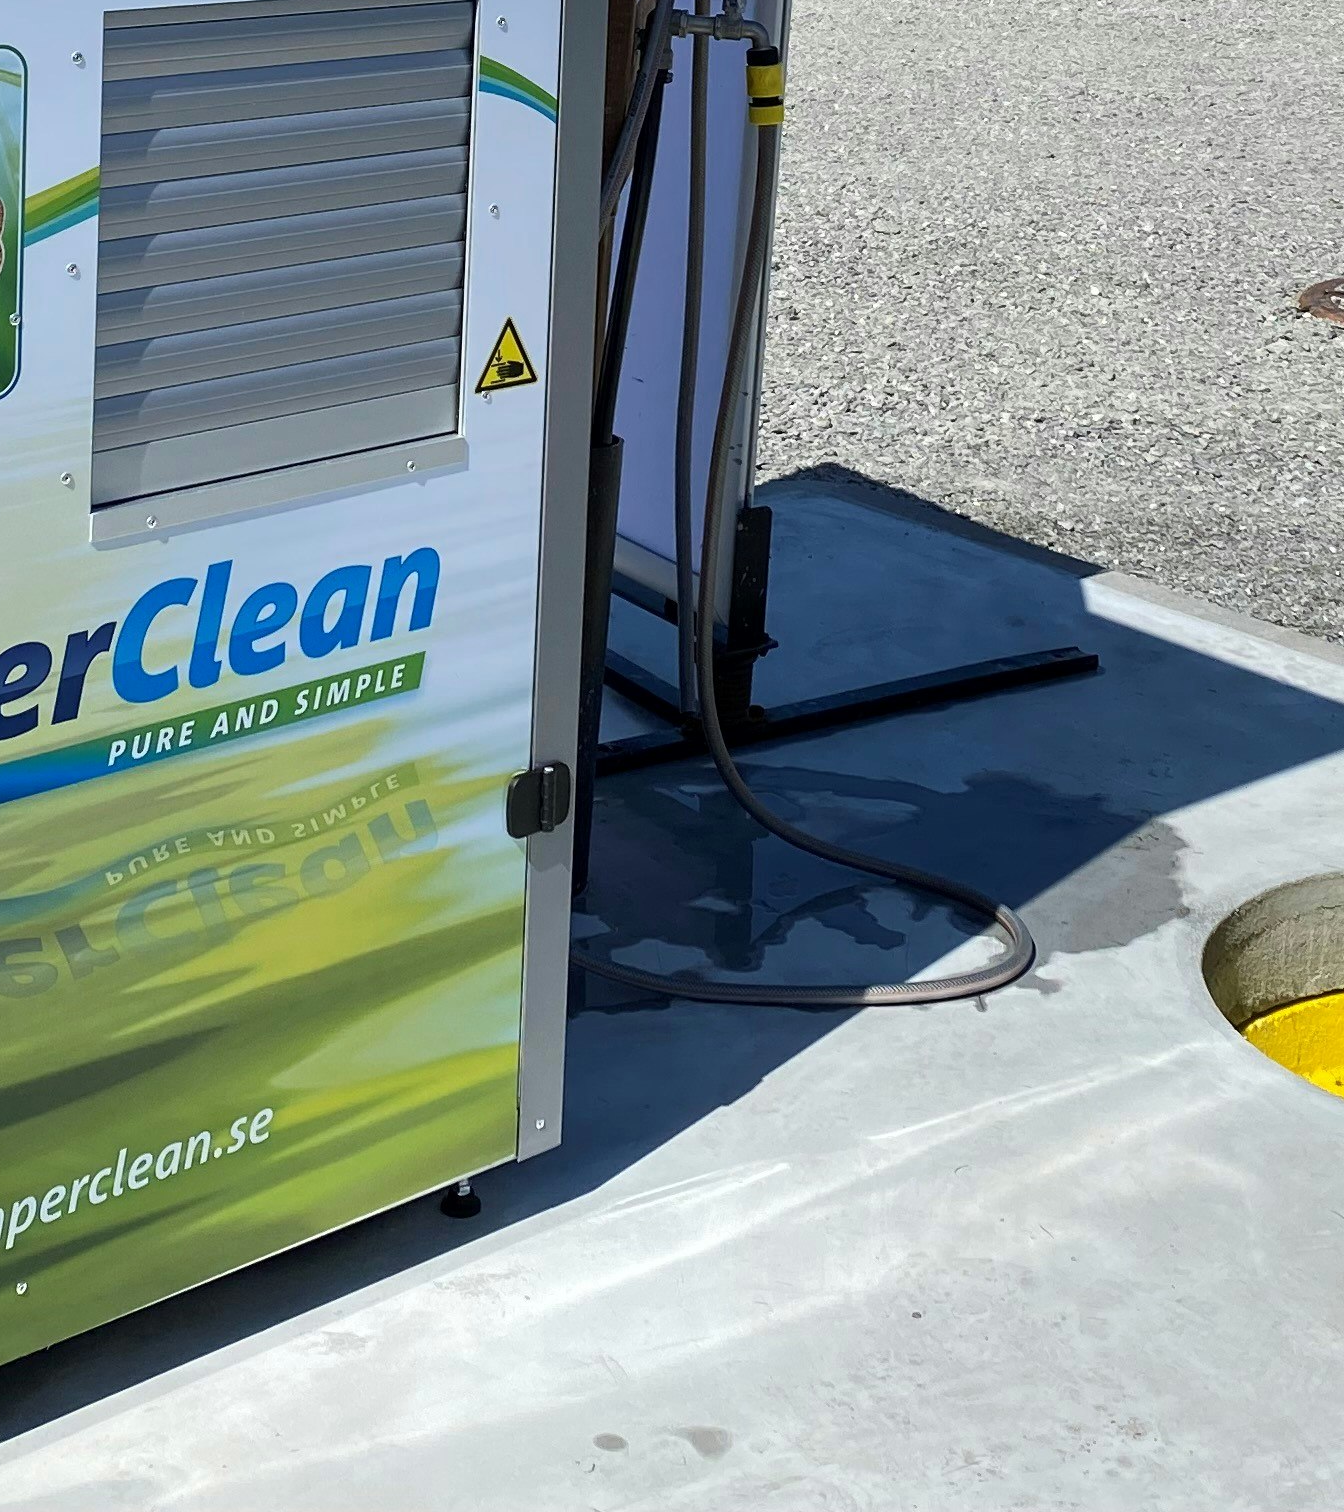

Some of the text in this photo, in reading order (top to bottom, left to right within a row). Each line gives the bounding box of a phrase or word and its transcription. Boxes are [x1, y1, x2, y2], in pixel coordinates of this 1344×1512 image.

[108, 663, 406, 767] PURE AND SIMPLE
